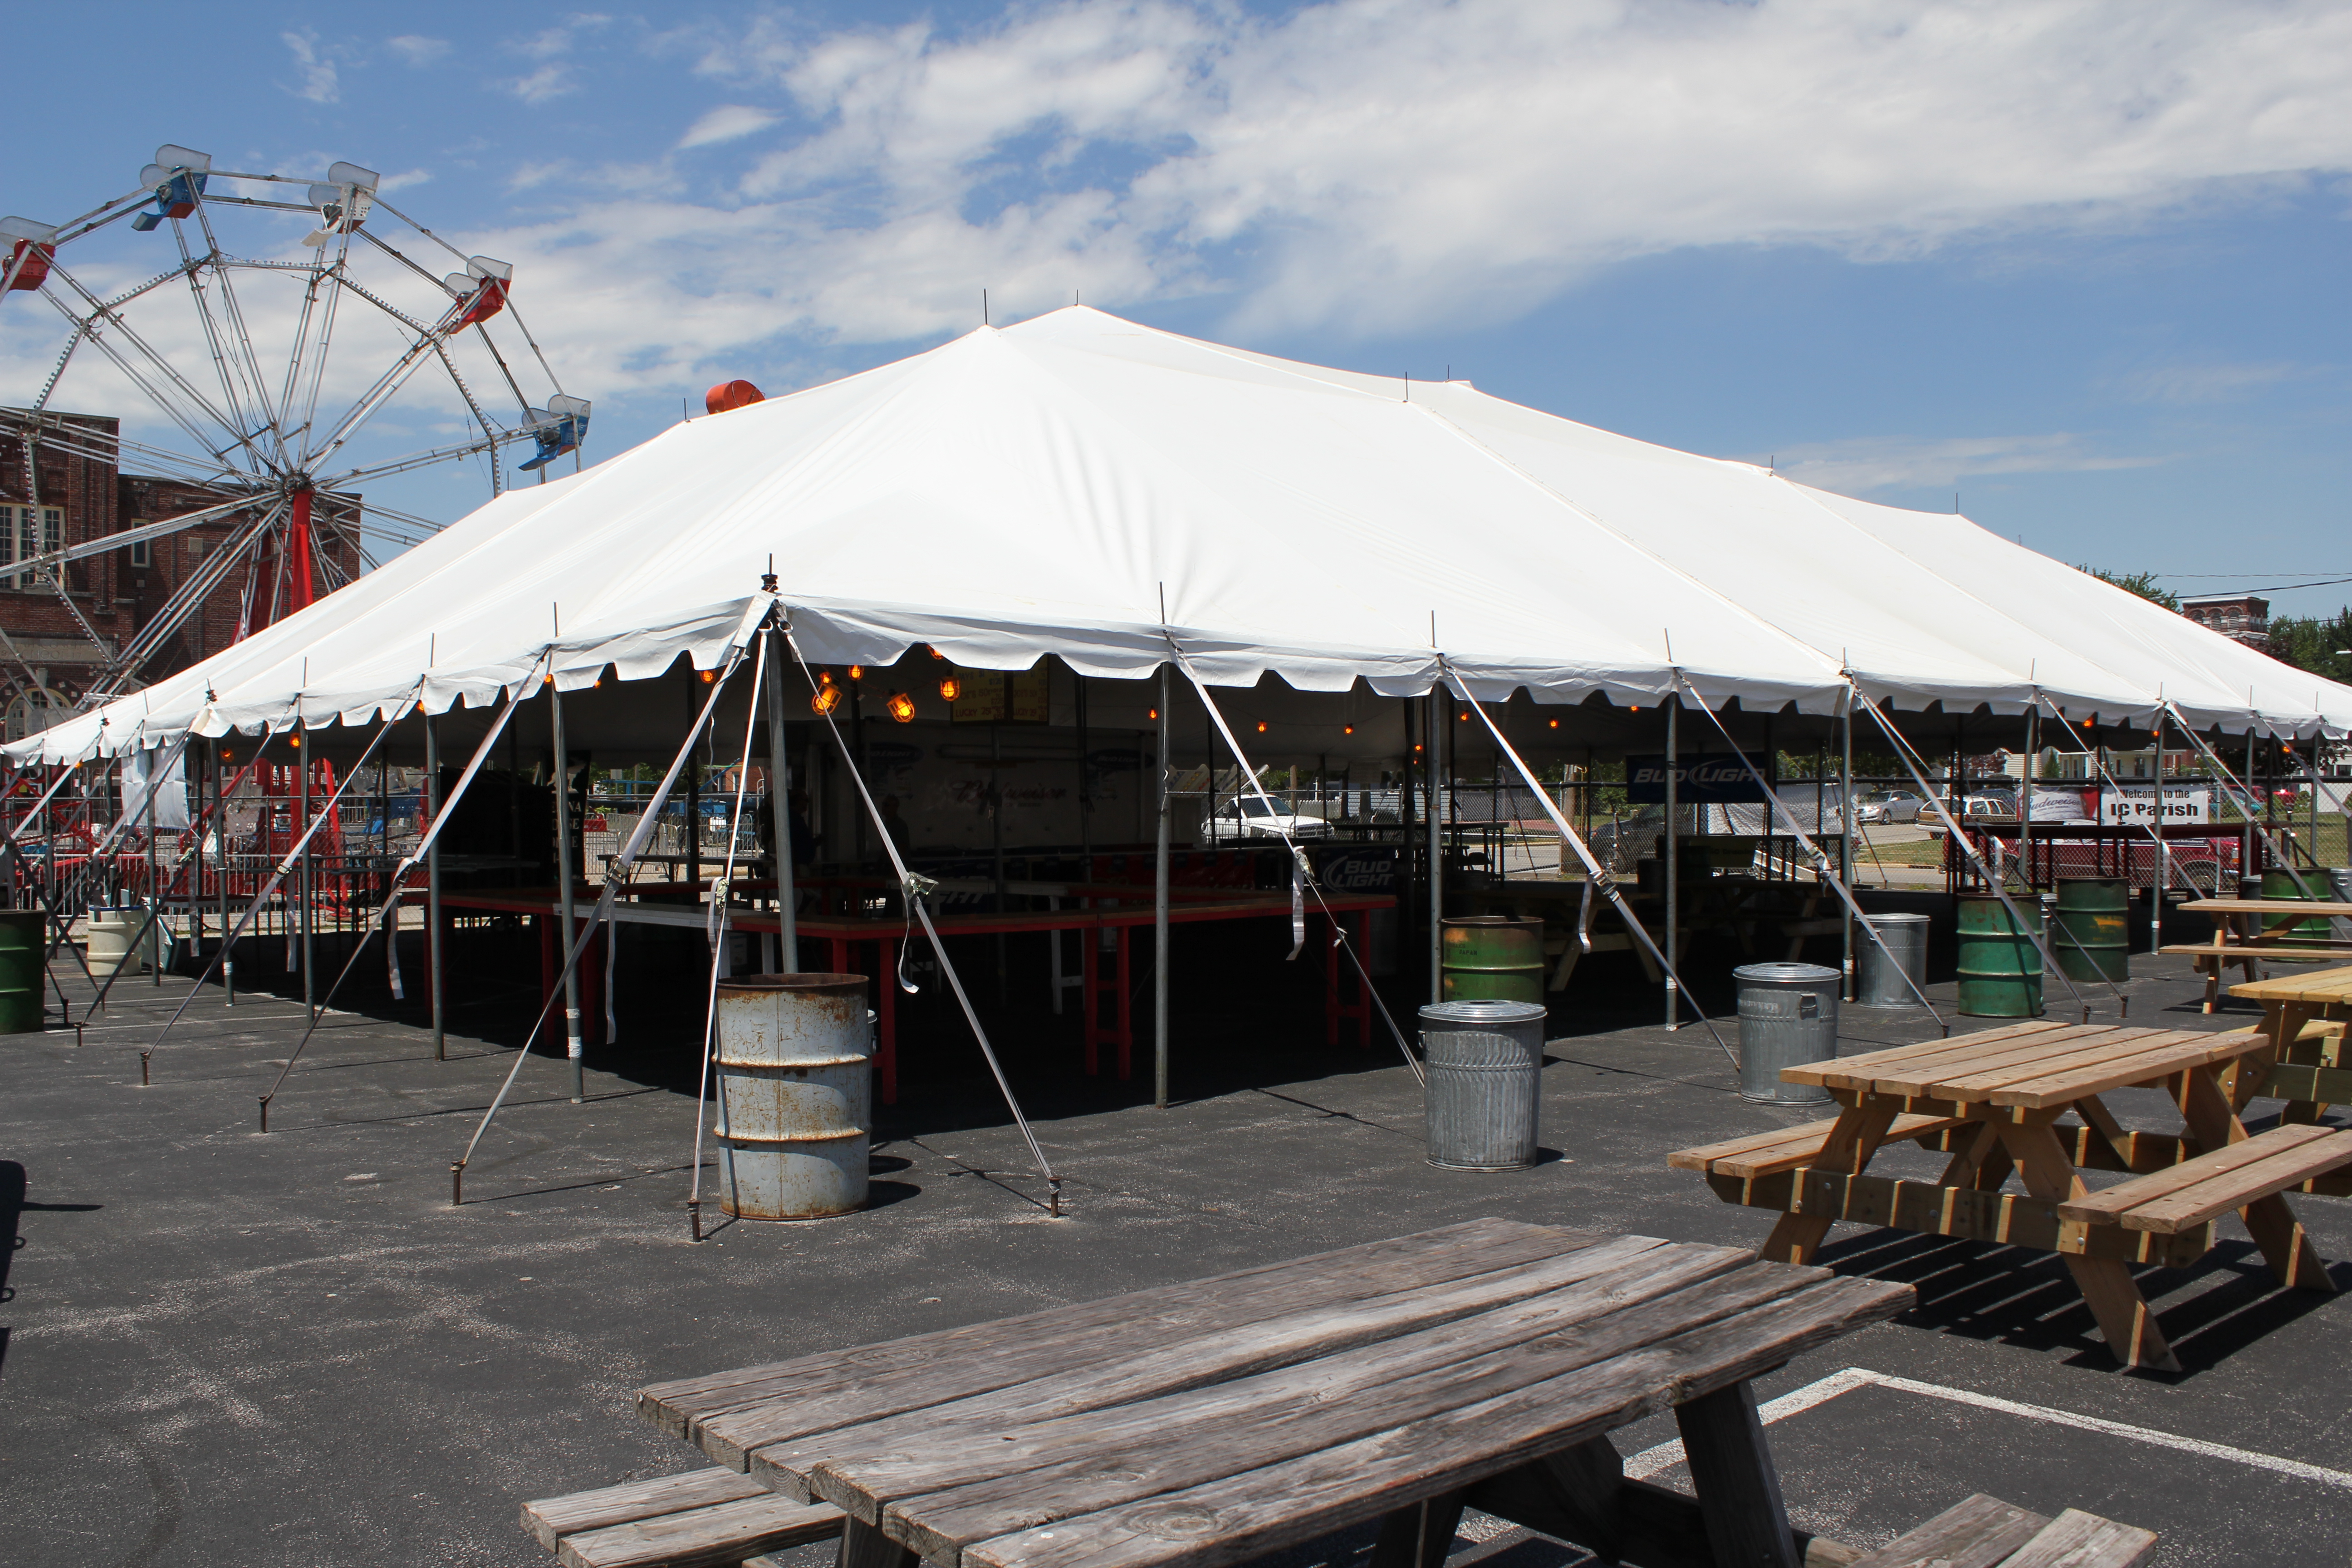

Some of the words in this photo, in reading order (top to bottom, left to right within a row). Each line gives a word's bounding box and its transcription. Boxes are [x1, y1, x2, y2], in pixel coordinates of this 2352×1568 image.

[2120, 789, 2156, 799] Welcom
[2164, 790, 2173, 799] to
[2175, 789, 2190, 799] the
[2110, 804, 2130, 816] IC
[2135, 804, 2199, 816] Parish
[1343, 860, 1392, 874] BUD
[1333, 873, 1395, 888] LIGHT
